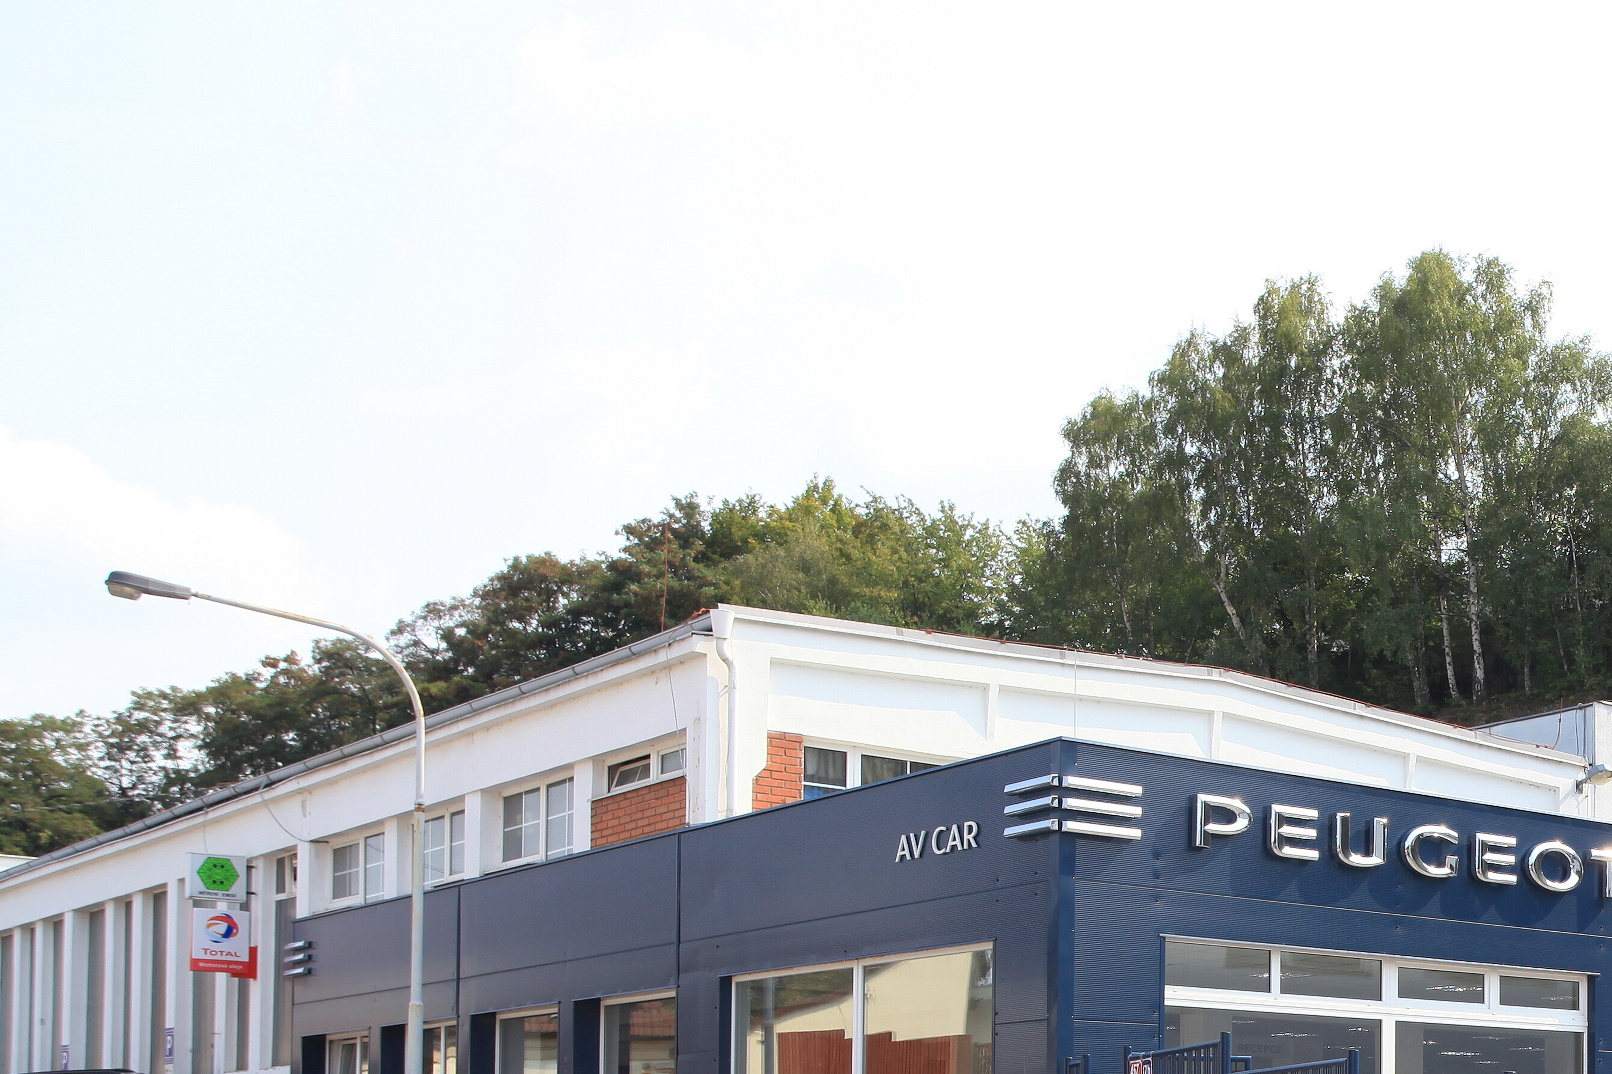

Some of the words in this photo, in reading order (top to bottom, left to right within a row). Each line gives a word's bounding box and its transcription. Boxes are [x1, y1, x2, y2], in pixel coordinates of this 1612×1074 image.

[894, 830, 927, 863] AV
[931, 820, 979, 855] CAR
[1238, 1043, 1283, 1054] RECEPCE
